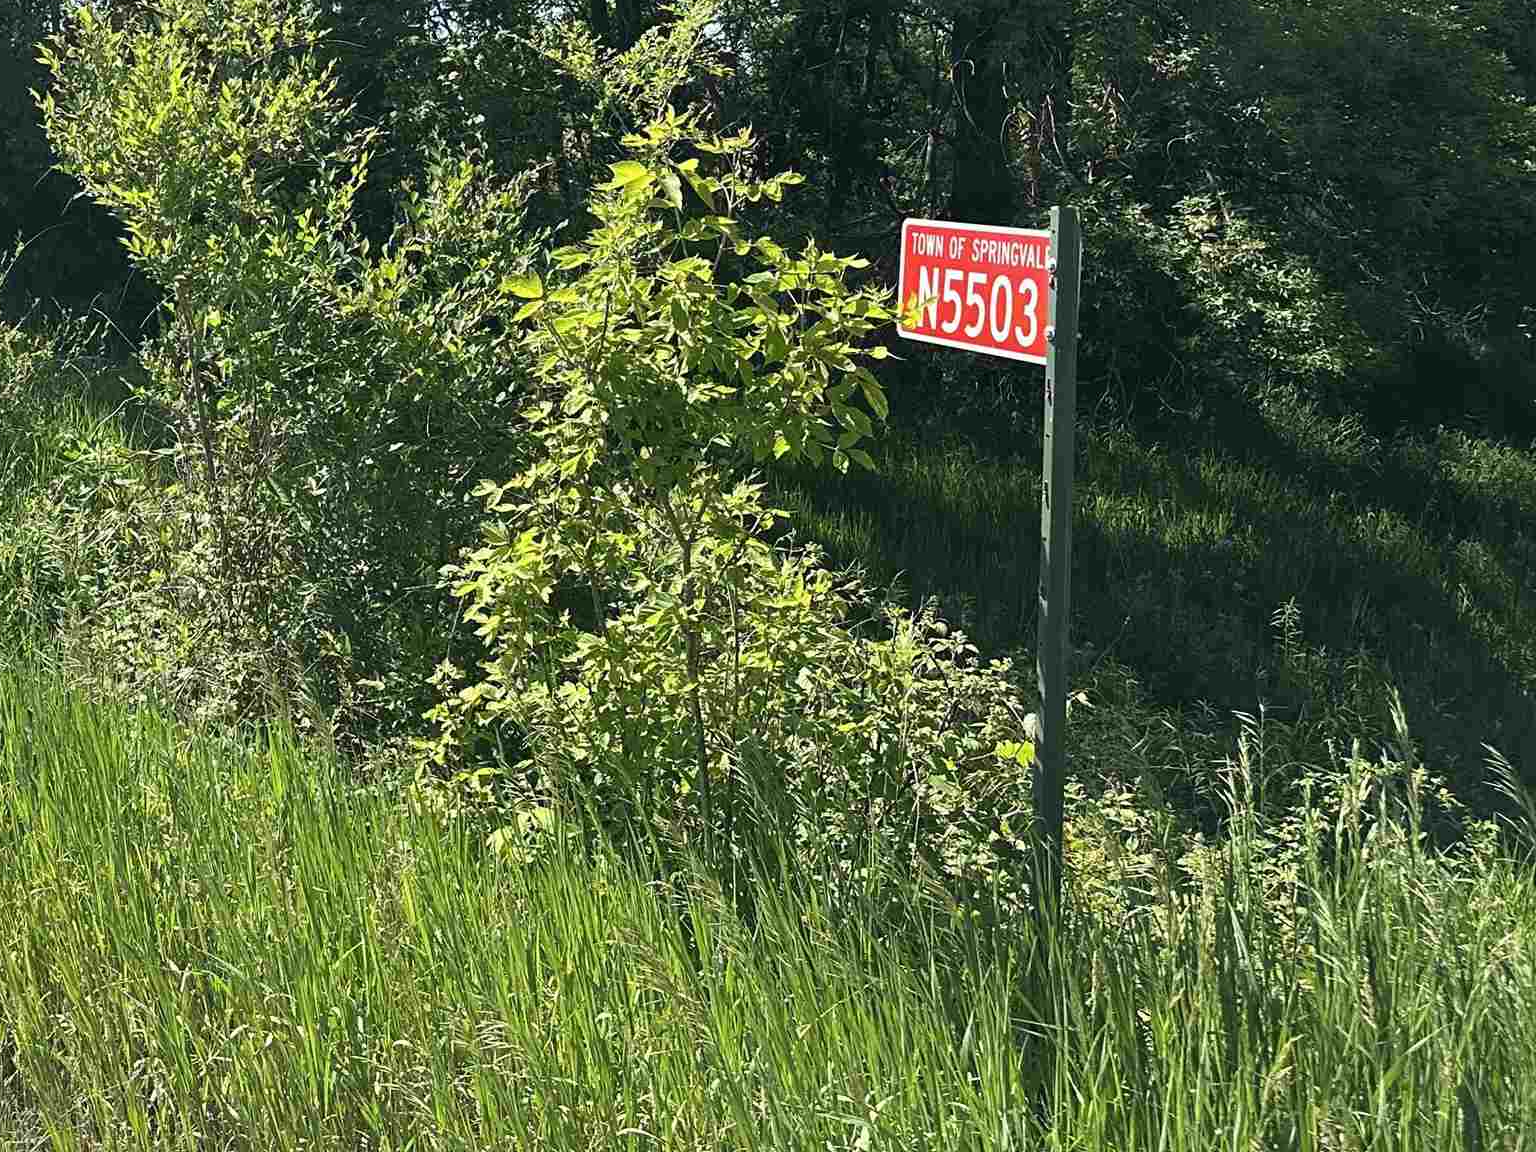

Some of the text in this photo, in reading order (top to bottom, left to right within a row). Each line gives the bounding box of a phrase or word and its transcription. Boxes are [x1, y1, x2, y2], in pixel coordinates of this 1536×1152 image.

[911, 232, 944, 257] TOWN
[949, 236, 966, 259] OF
[916, 265, 1039, 347] N5503
